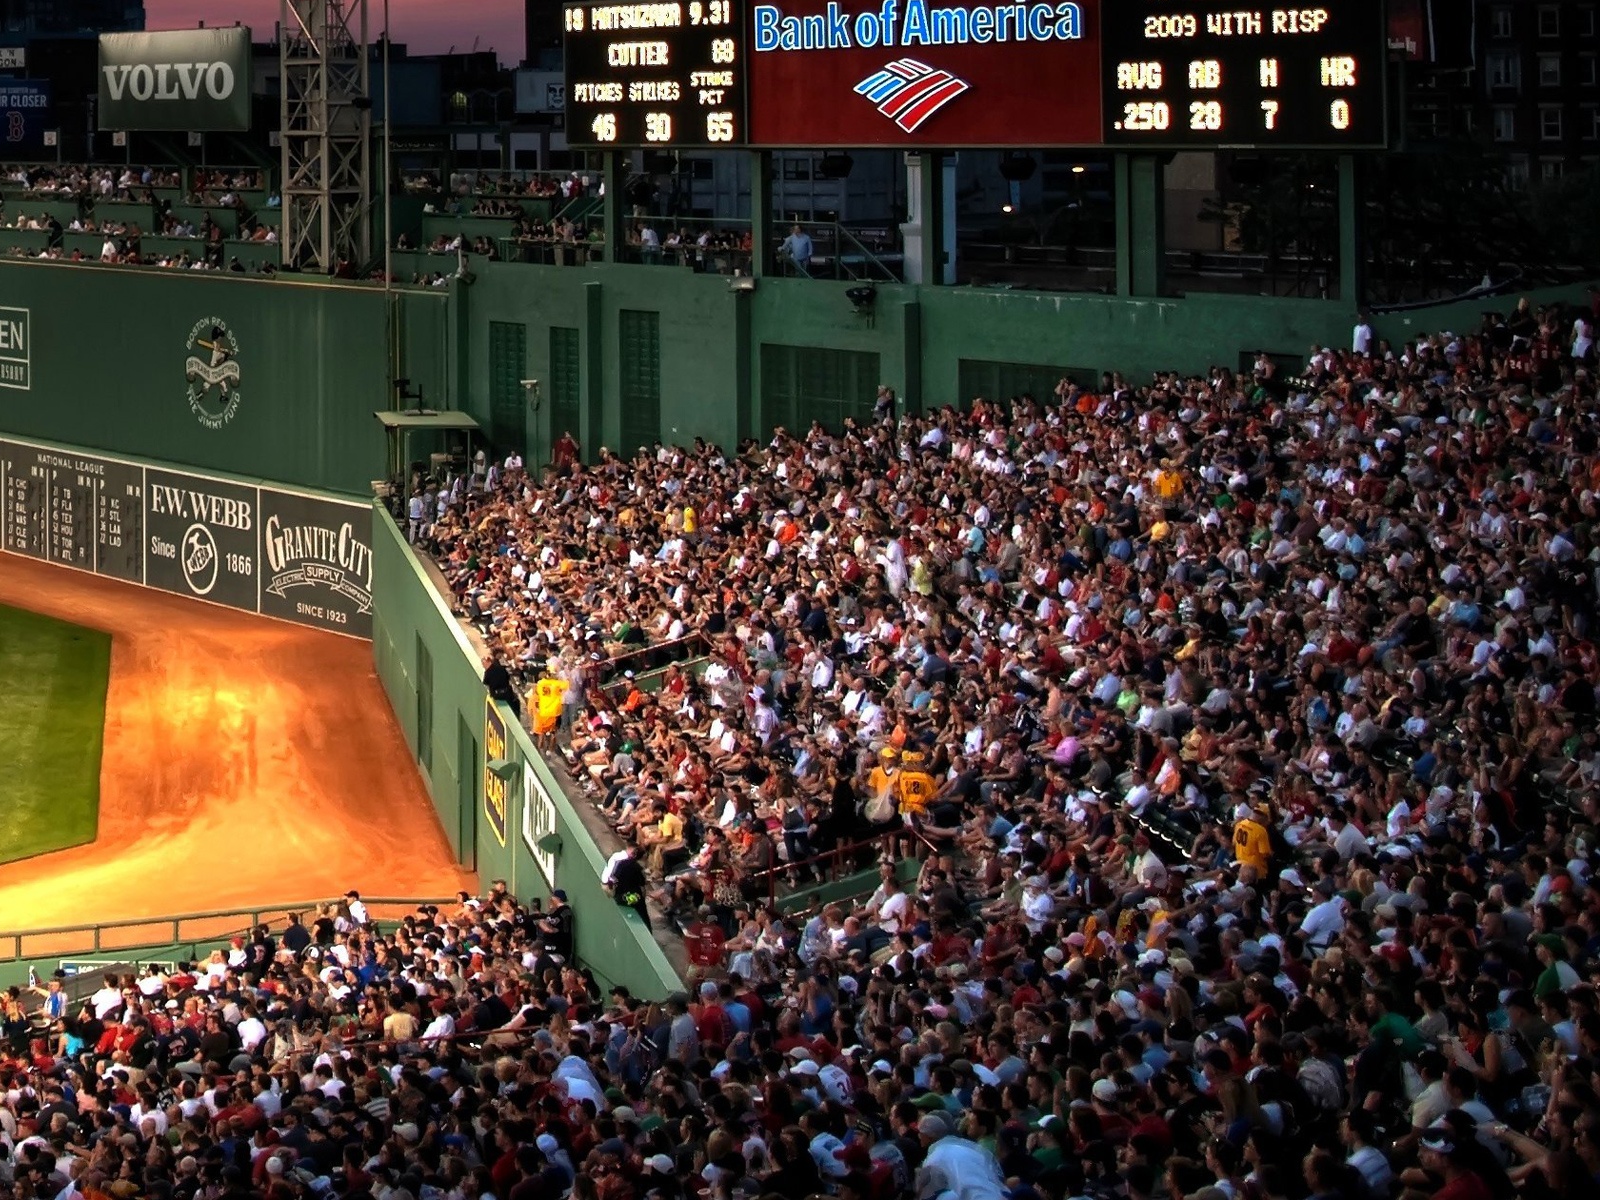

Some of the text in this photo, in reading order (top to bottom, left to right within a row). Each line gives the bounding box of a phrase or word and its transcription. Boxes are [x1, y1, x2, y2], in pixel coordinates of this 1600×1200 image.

[689, 0, 730, 25] 9.31
[754, 1, 851, 51] Bank
[1144, 9, 1329, 38] 2009 WITH RISP
[608, 41, 669, 66] CUTTER
[102, 61, 234, 101] VOLVO
[690, 71, 734, 88] STRIKE
[1117, 56, 1356, 90] AVG AB H HR
[574, 81, 681, 102] PITCHES STRIKES
[698, 89, 725, 105] PCT
[10, 94, 48, 108] CLOSER
[1113, 99, 1349, 130] .250 28 7 0
[591, 111, 734, 142] 46 30 65
[186, 316, 240, 353] BOSTON RED SOX
[197, 415, 223, 429] JIMMY
[224, 392, 240, 424] FUND
[7, 461, 44, 478] P IN R
[37, 453, 104, 475] NATIONAL LEAGUE
[15, 478, 27, 490] CHC
[52, 470, 91, 488] P IN R
[63, 488, 71, 499] TB
[99, 479, 141, 497] P IN R
[15, 502, 27, 514] BAL
[61, 499, 72, 511] FLA
[111, 498, 120, 509] KC
[151, 483, 251, 531] F.W. WEBB
[15, 514, 27, 525] WAS
[61, 512, 72, 524] TEX
[109, 510, 121, 522] STL
[15, 526, 27, 538] CLE
[60, 524, 73, 536] HOU
[109, 523, 121, 535] LAA
[16, 537, 27, 549] CIN
[61, 536, 72, 549] TOR
[109, 535, 121, 547] LAD
[265, 514, 337, 573] GRANITE
[61, 550, 72, 561] ATL
[151, 536, 176, 560] Since
[226, 552, 251, 576] 1866
[275, 566, 369, 604] ELECTRIC SUPPLY COMPANY
[296, 602, 347, 624] SINCE 1923
